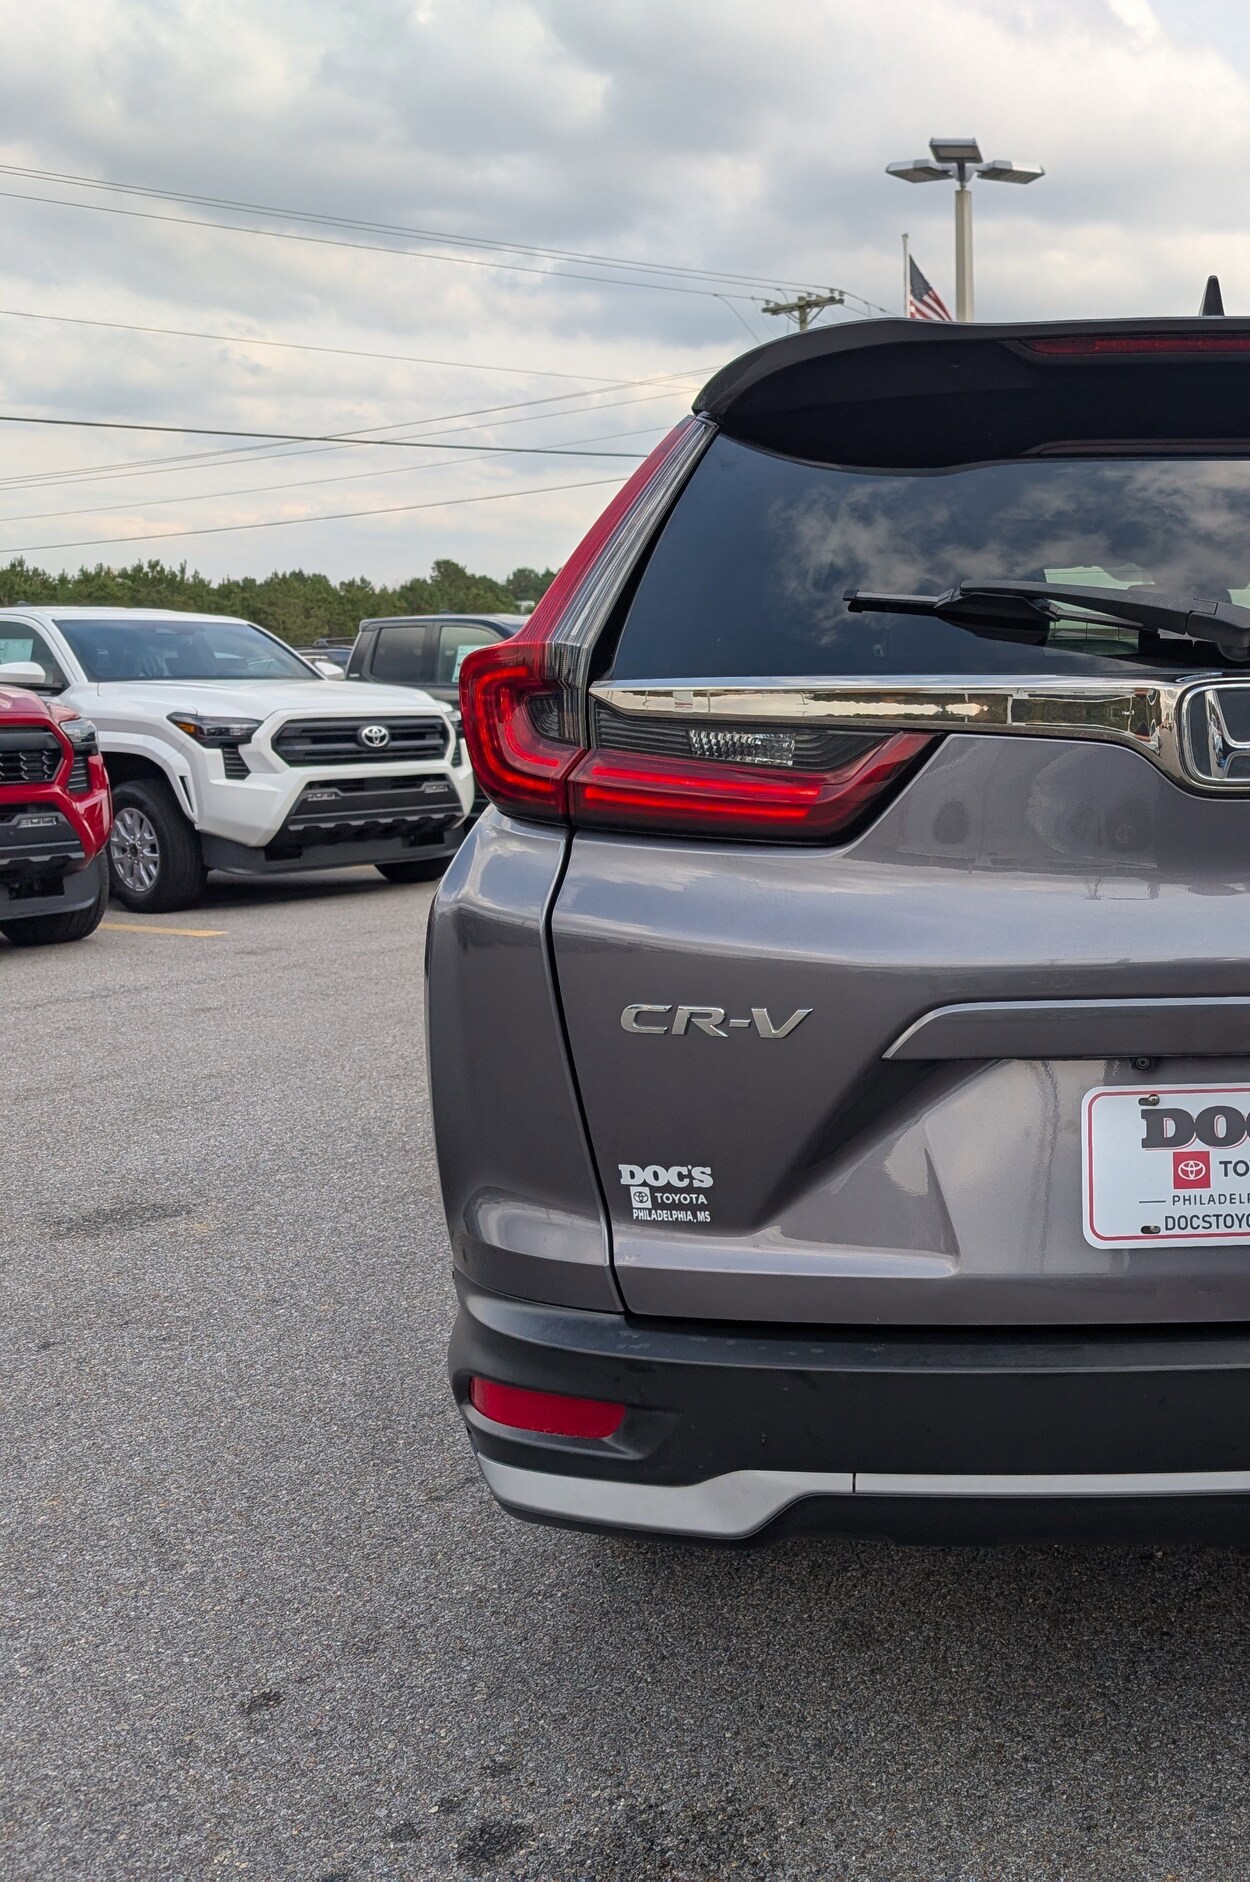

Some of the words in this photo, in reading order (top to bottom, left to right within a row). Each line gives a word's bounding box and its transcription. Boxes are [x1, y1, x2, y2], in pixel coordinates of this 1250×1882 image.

[620, 1004, 813, 1038] CR-V
[618, 1164, 714, 1188] DOC'S
[655, 1193, 708, 1204] TOYOTA
[632, 1209, 697, 1222] PHILADELPHIA,
[697, 1211, 711, 1222] MS
